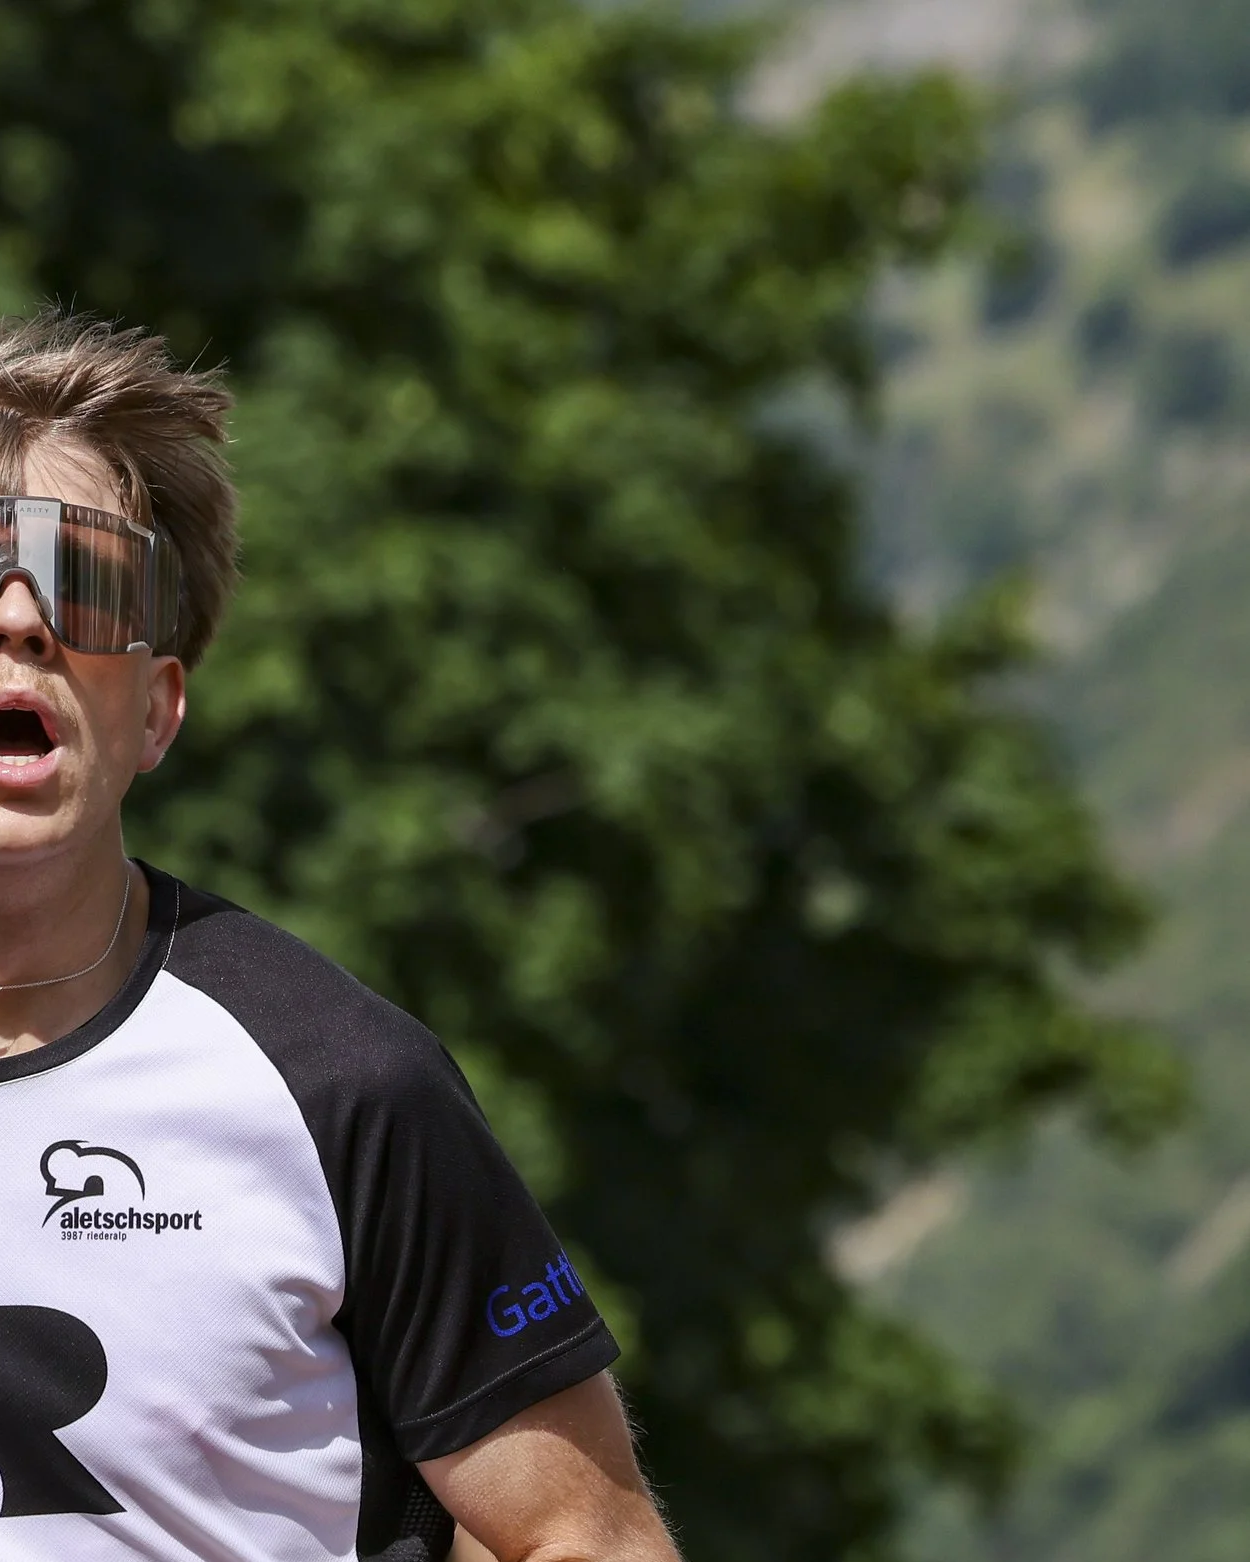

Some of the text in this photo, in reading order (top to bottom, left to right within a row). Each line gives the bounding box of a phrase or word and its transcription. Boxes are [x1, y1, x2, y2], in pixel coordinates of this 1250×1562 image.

[60, 1206, 203, 1234] aletschsport
[60, 1230, 128, 1242] 3987 riederalp
[486, 1248, 583, 1338] Gatt
